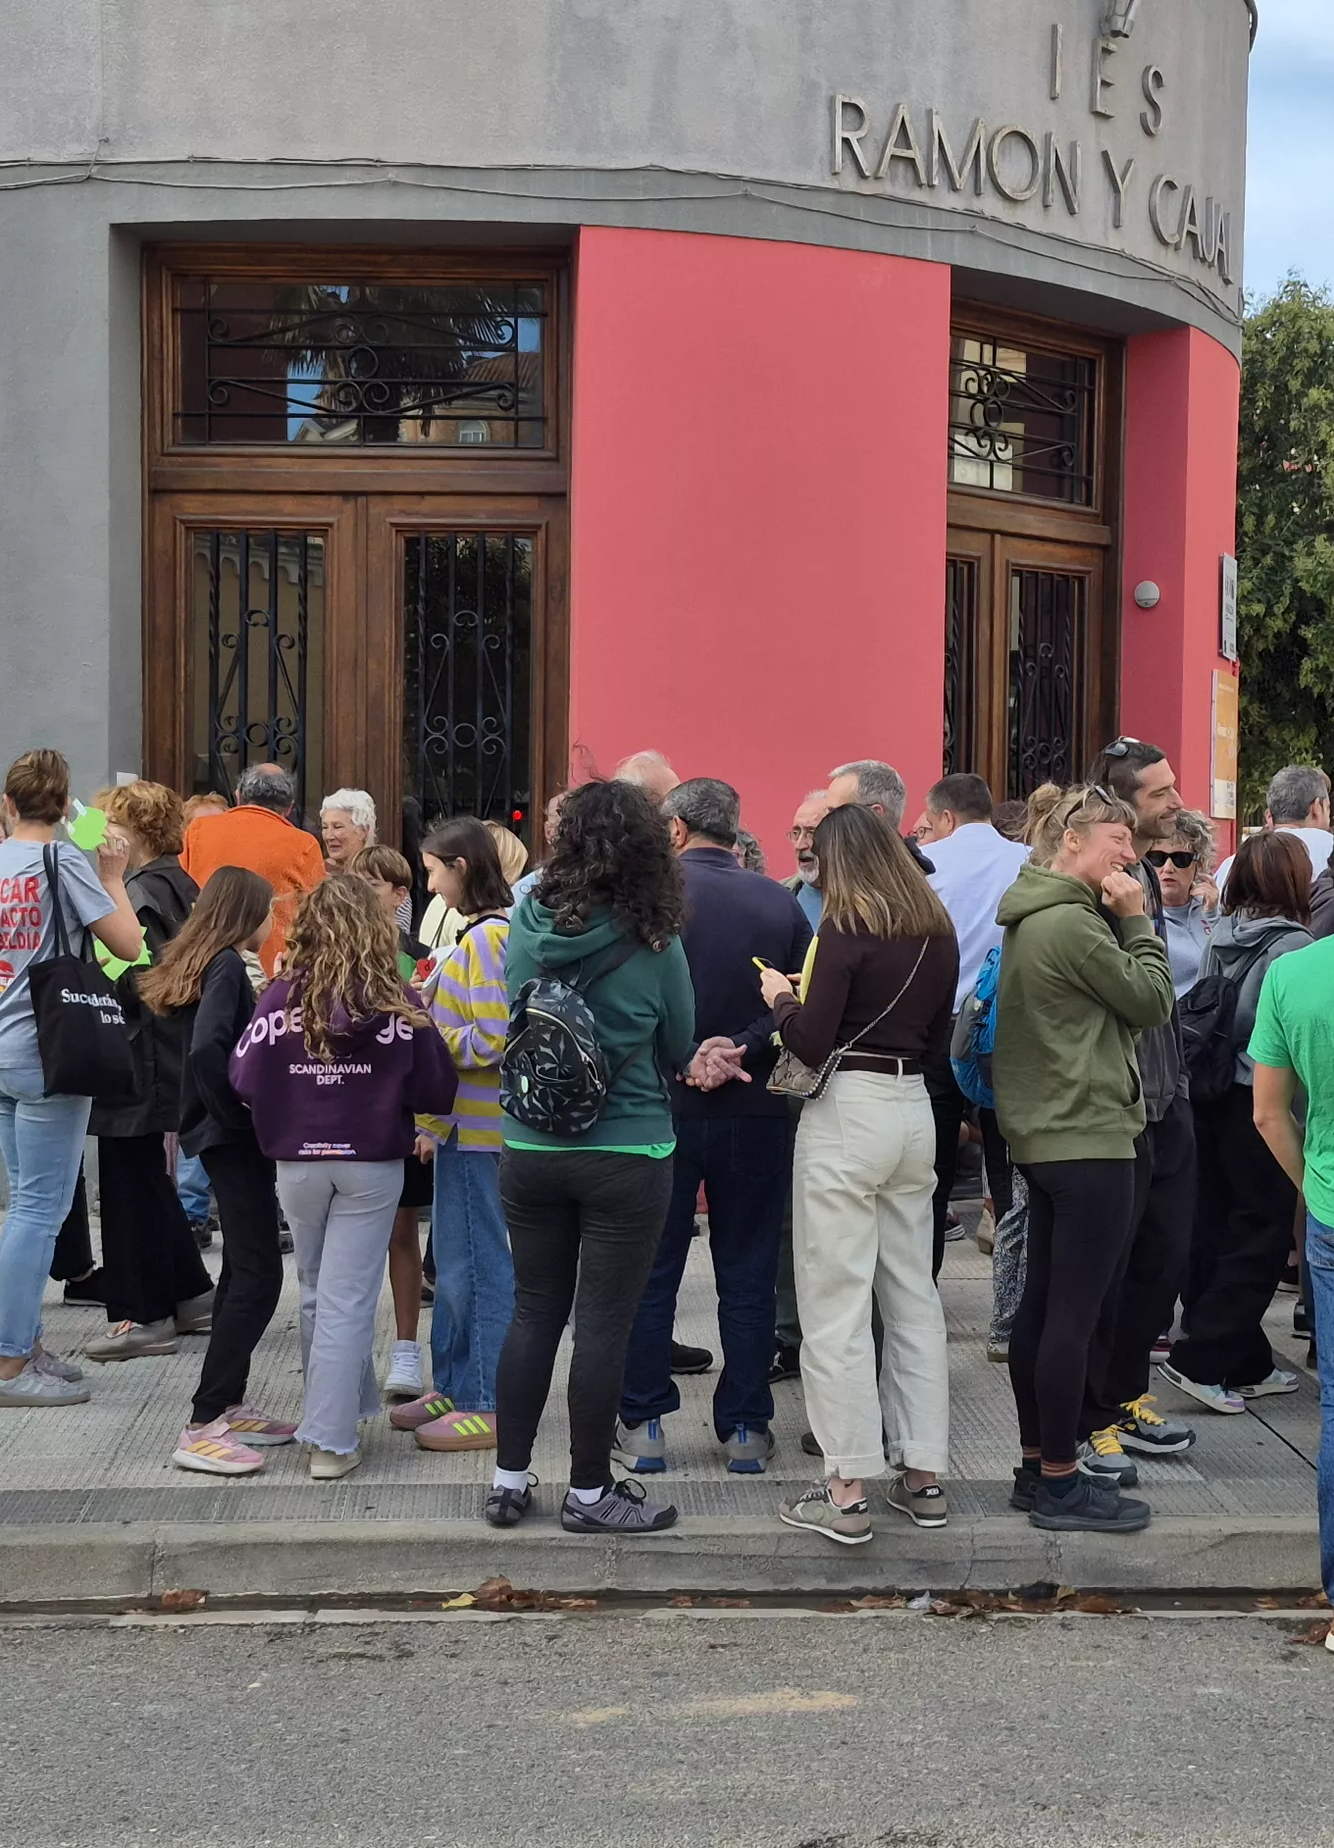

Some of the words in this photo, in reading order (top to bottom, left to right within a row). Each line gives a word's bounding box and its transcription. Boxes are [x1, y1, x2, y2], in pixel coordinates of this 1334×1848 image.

[831, 94, 1081, 215] RAMON
[1102, 149, 1135, 228] Y
[0, 905, 43, 928] ACTO
[100, 1010, 112, 1023] lo
[289, 1064, 372, 1074] SCANDINAVIAN
[317, 1075, 345, 1085] DEPT.
